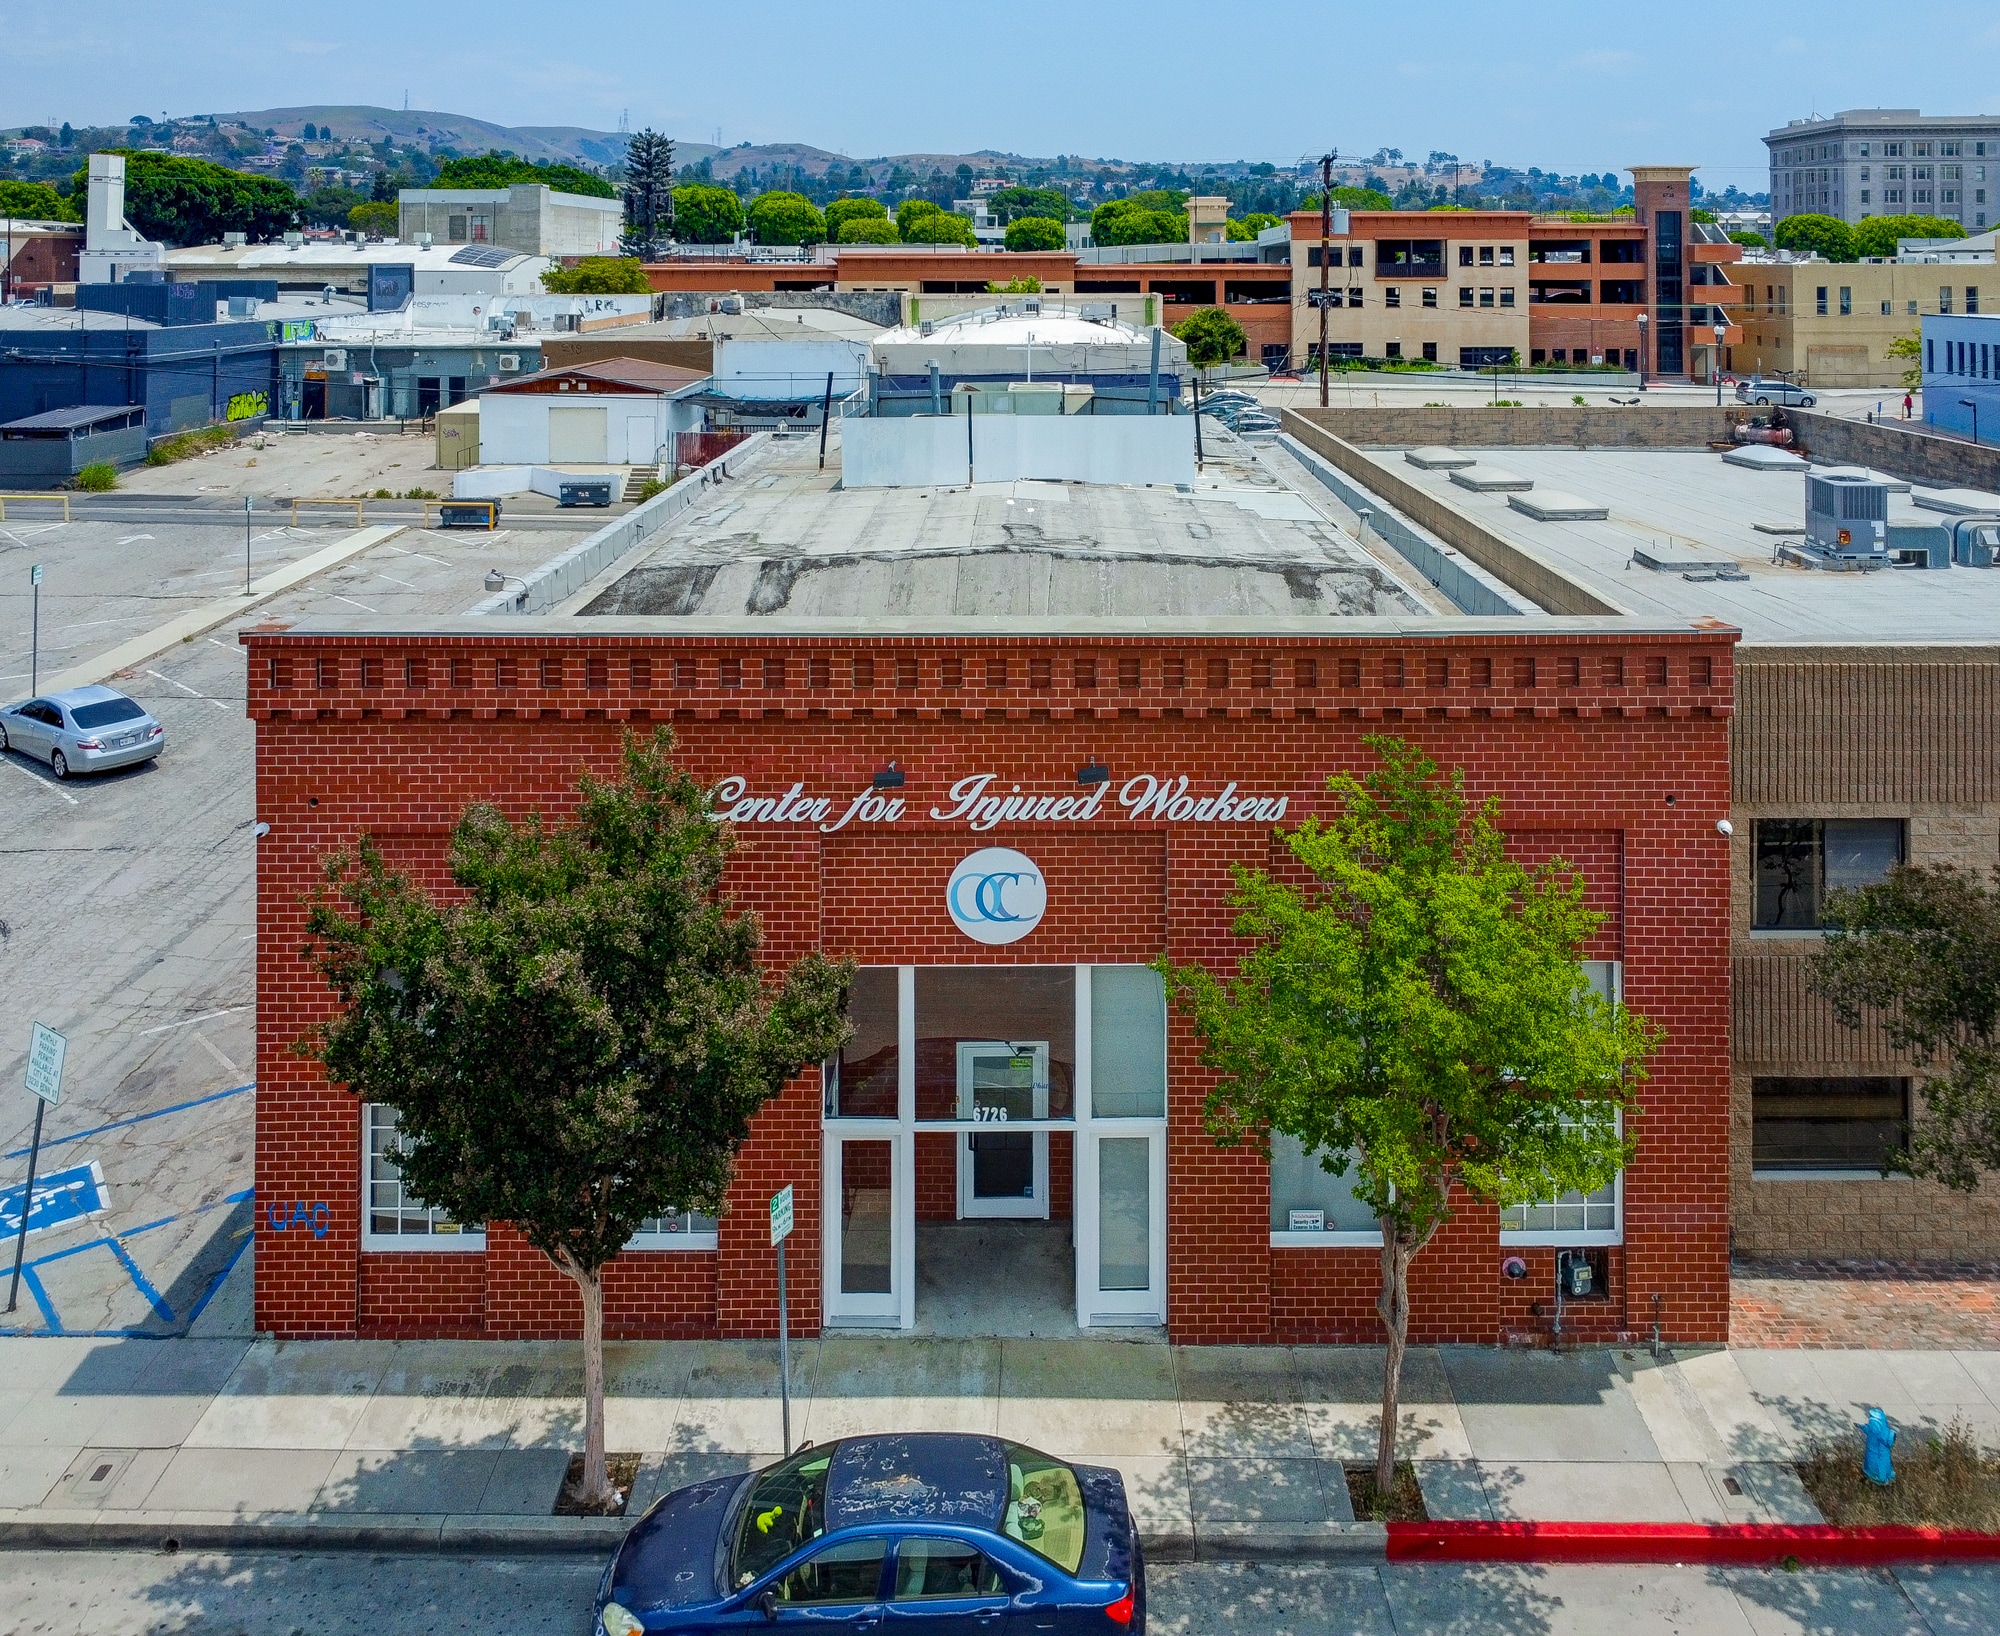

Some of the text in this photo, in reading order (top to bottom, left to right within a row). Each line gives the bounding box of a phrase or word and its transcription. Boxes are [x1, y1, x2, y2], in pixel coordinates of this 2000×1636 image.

[702, 773, 1289, 832] Center for Injured Workers
[39, 1041, 57, 1056] PARKING
[38, 1050, 55, 1066] PERMITS
[31, 1057, 52, 1076] AVAILABLE
[973, 1107, 1008, 1121] 6726
[772, 1198, 778, 1211] 2
[772, 1201, 791, 1223] PARKING
